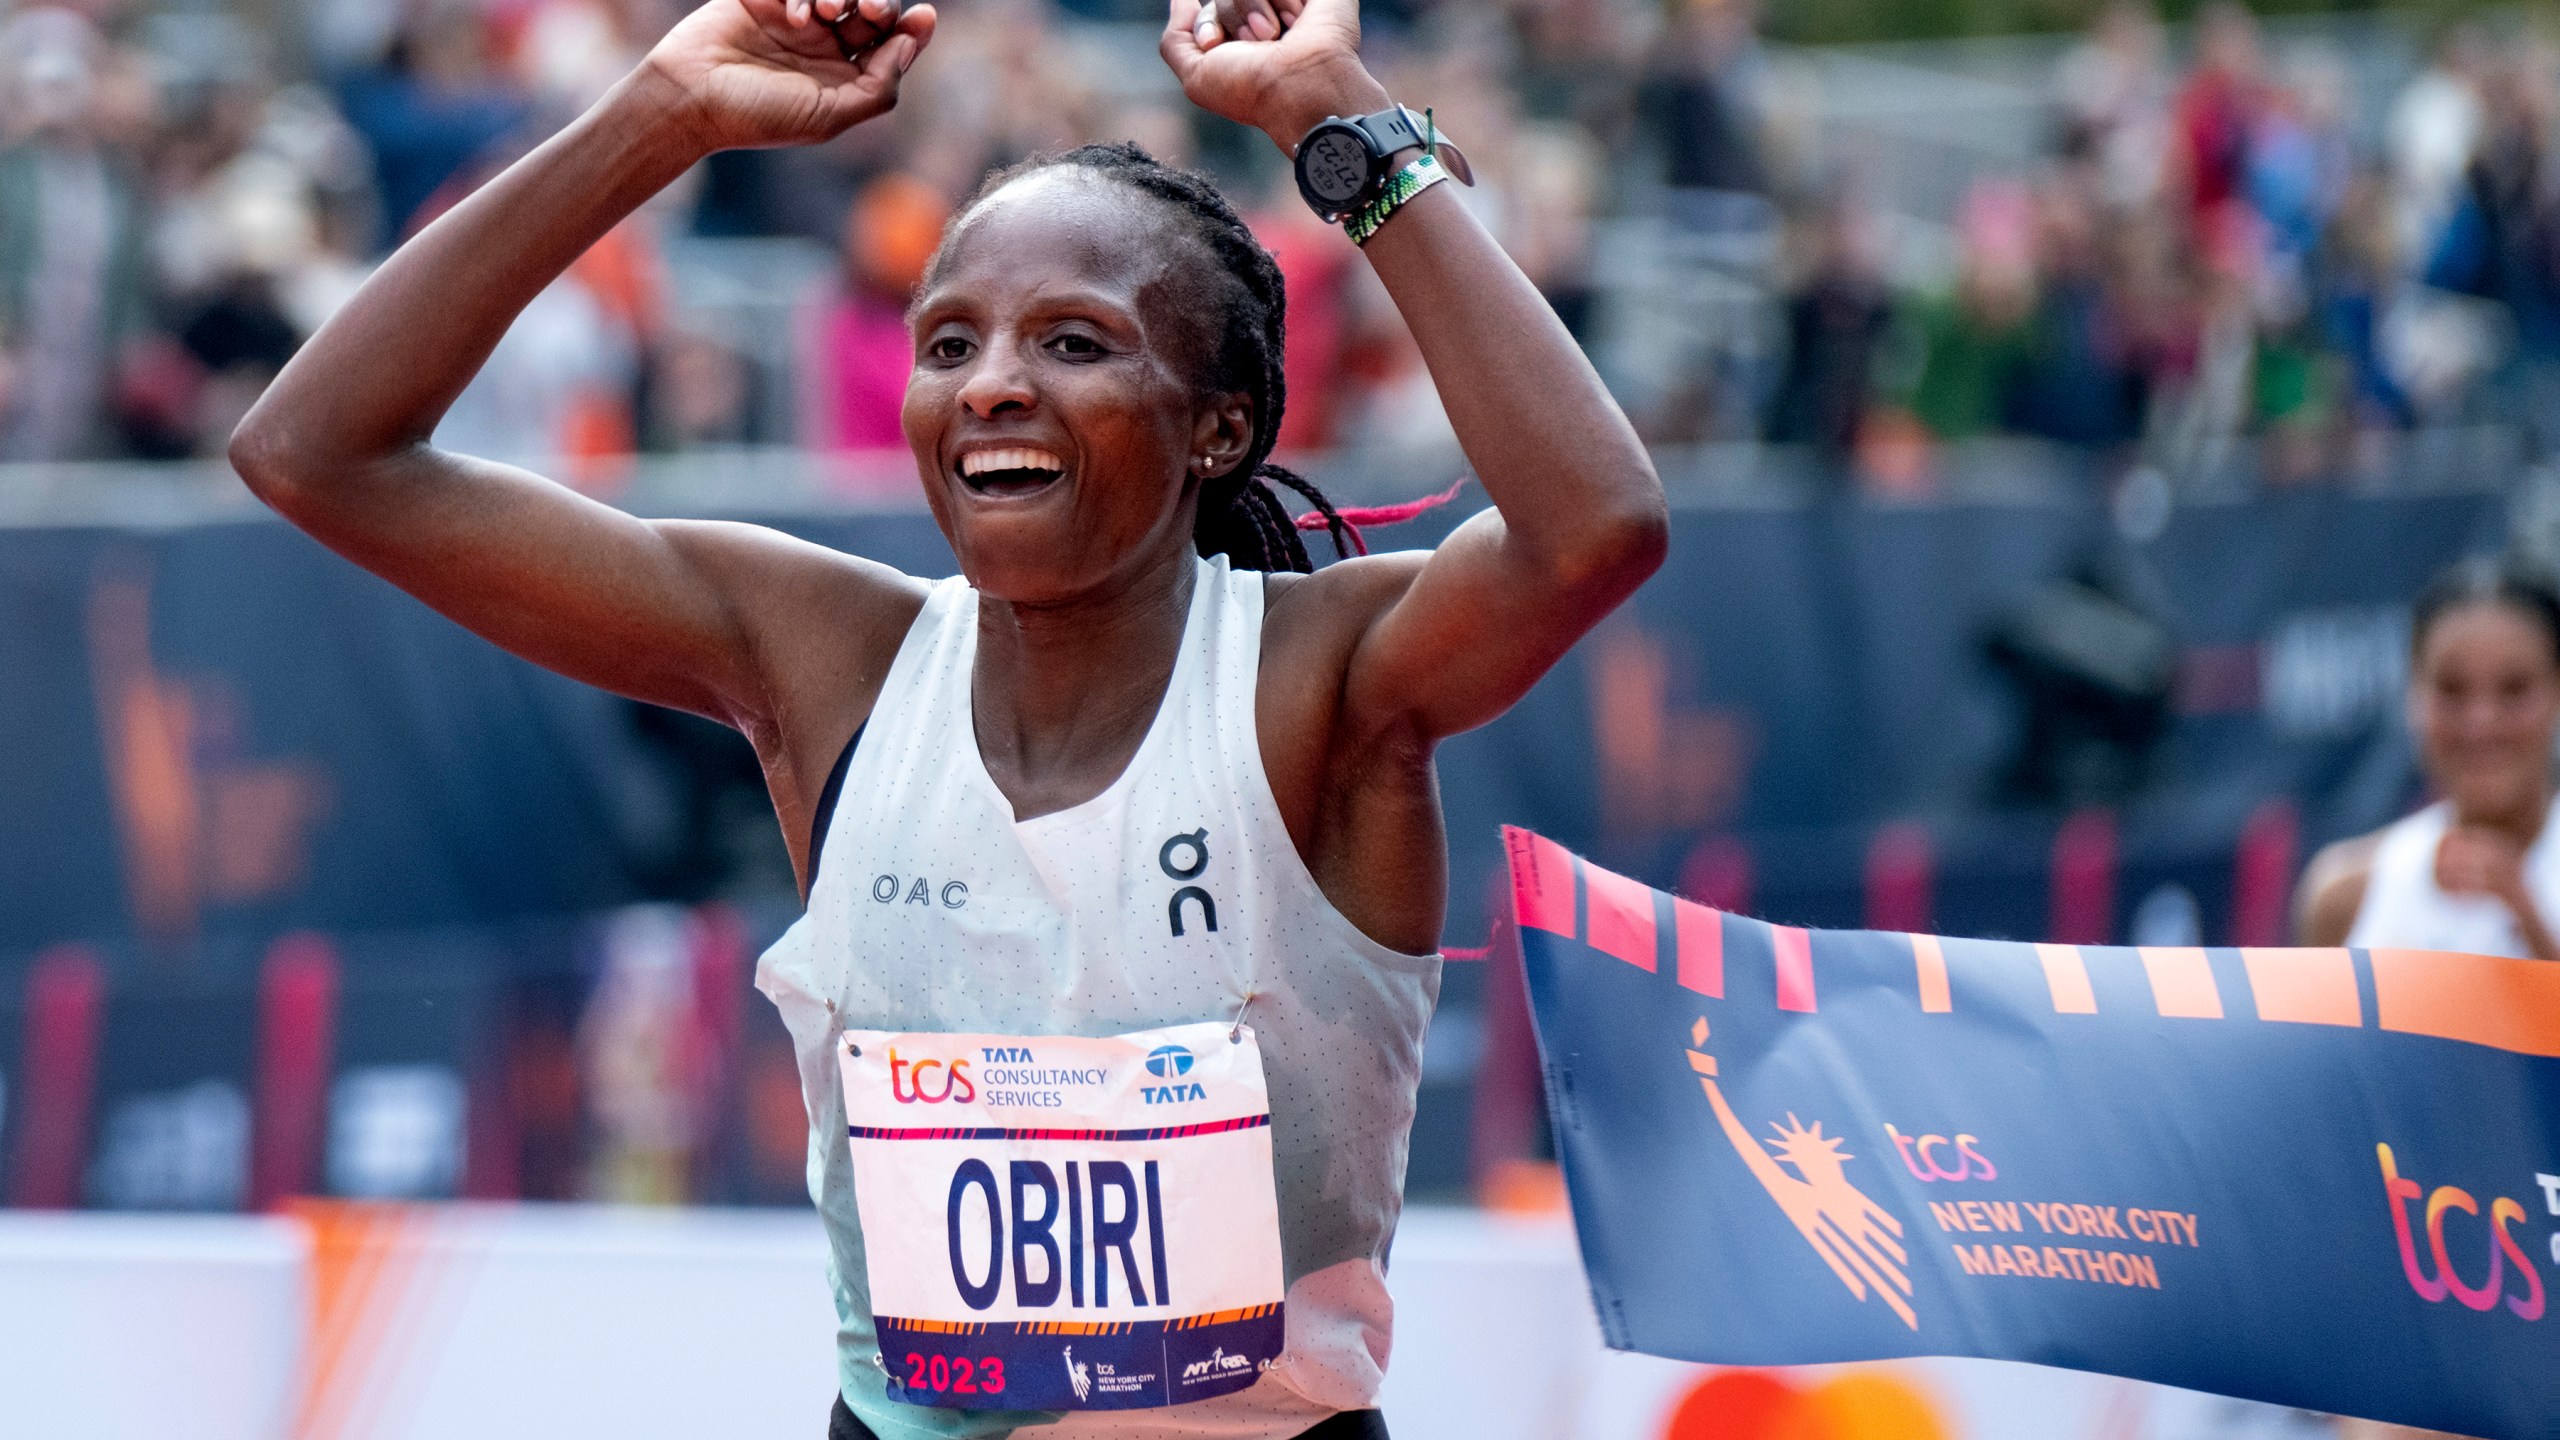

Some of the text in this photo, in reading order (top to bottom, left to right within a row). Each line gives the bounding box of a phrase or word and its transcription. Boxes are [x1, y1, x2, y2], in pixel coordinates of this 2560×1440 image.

[1317, 138, 1359, 188] 27:22
[872, 873, 969, 909] OAC
[981, 1047, 1034, 1063] TATA
[889, 1046, 976, 1105] tcs
[983, 1068, 1107, 1086] CONSULTANCY
[1140, 1083, 1207, 1105] TATA
[986, 1090, 1062, 1107] SERVICES
[1884, 1122, 1998, 1182] tcs
[947, 1157, 1170, 1311] OBIRI
[1928, 1200, 2200, 1247] NEW YORK CITY
[2375, 1142, 2546, 1323] tcs
[1952, 1244, 2161, 1290] MARATHON
[905, 1352, 1006, 1394] 2023
[1096, 1362, 1115, 1375] tcs
[1098, 1374, 1156, 1384] NEW YORK CITY
[1099, 1383, 1142, 1392] MARATHON
